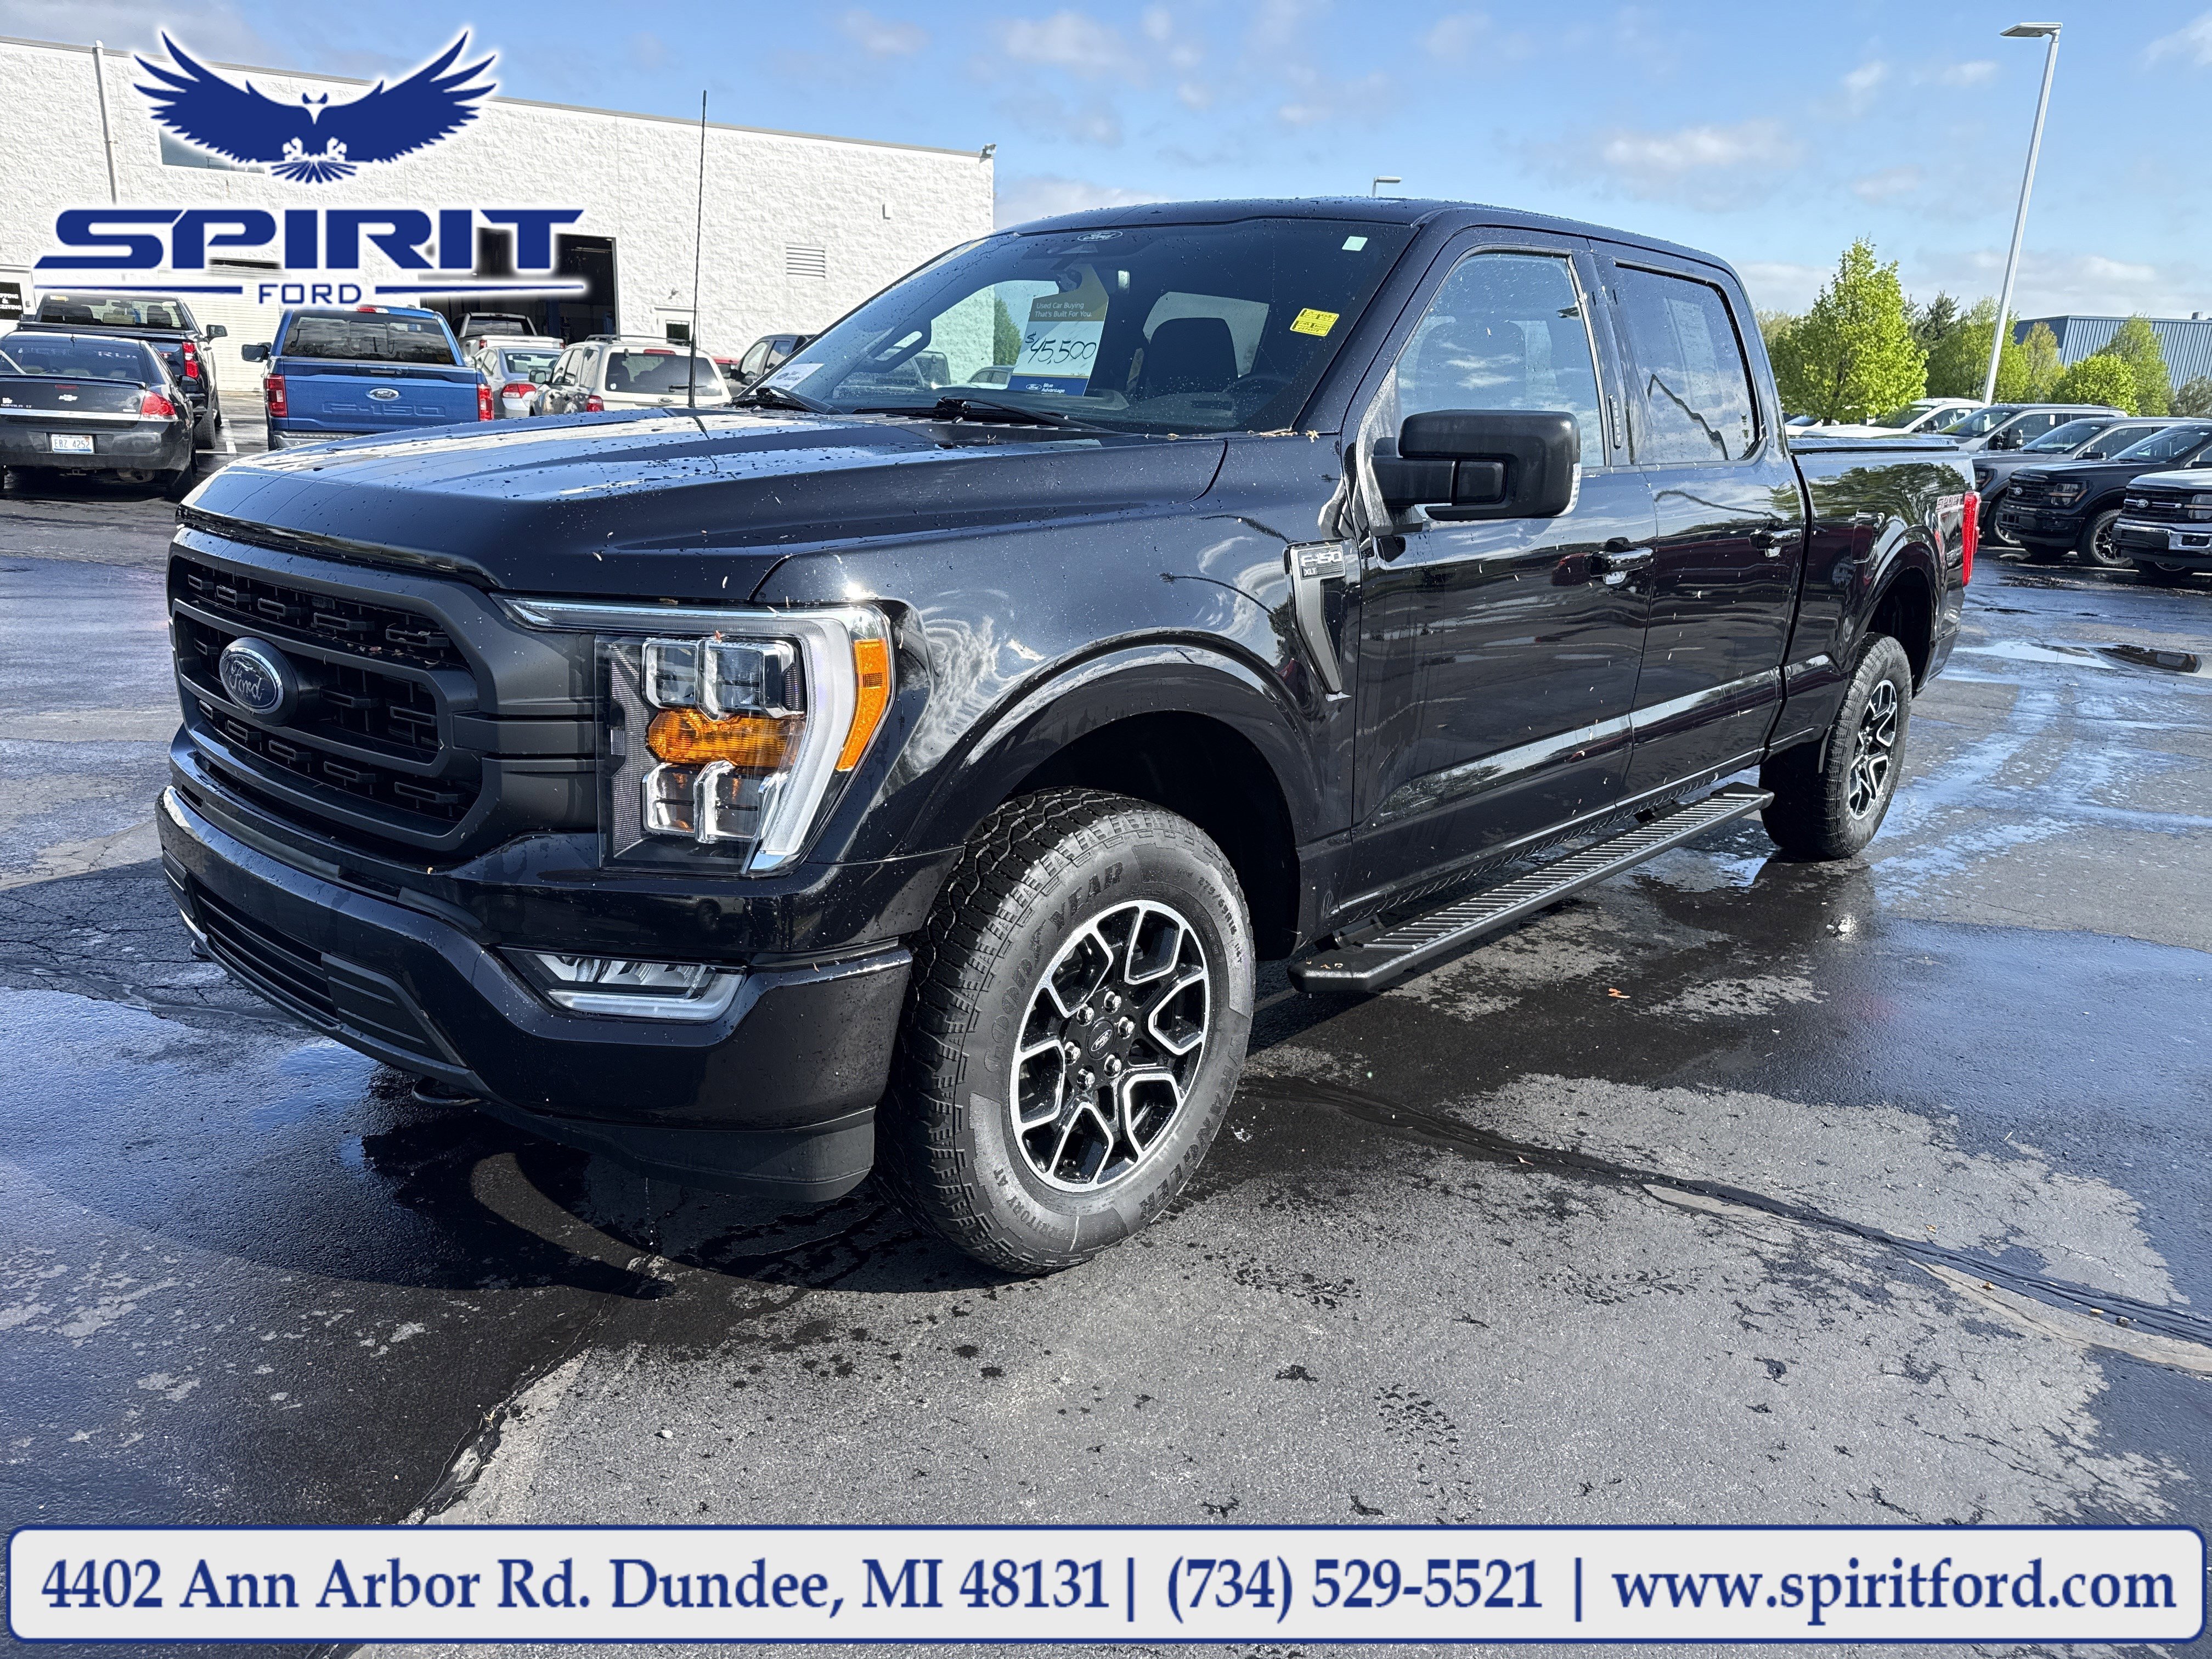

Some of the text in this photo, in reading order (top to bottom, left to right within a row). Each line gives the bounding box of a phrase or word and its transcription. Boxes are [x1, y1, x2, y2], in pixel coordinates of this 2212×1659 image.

[1025, 331, 1097, 365] $45,500
[321, 402, 446, 417] F-150
[1301, 551, 1343, 567] F-150
[1304, 568, 1317, 577] XLT
[226, 659, 265, 701] Ford
